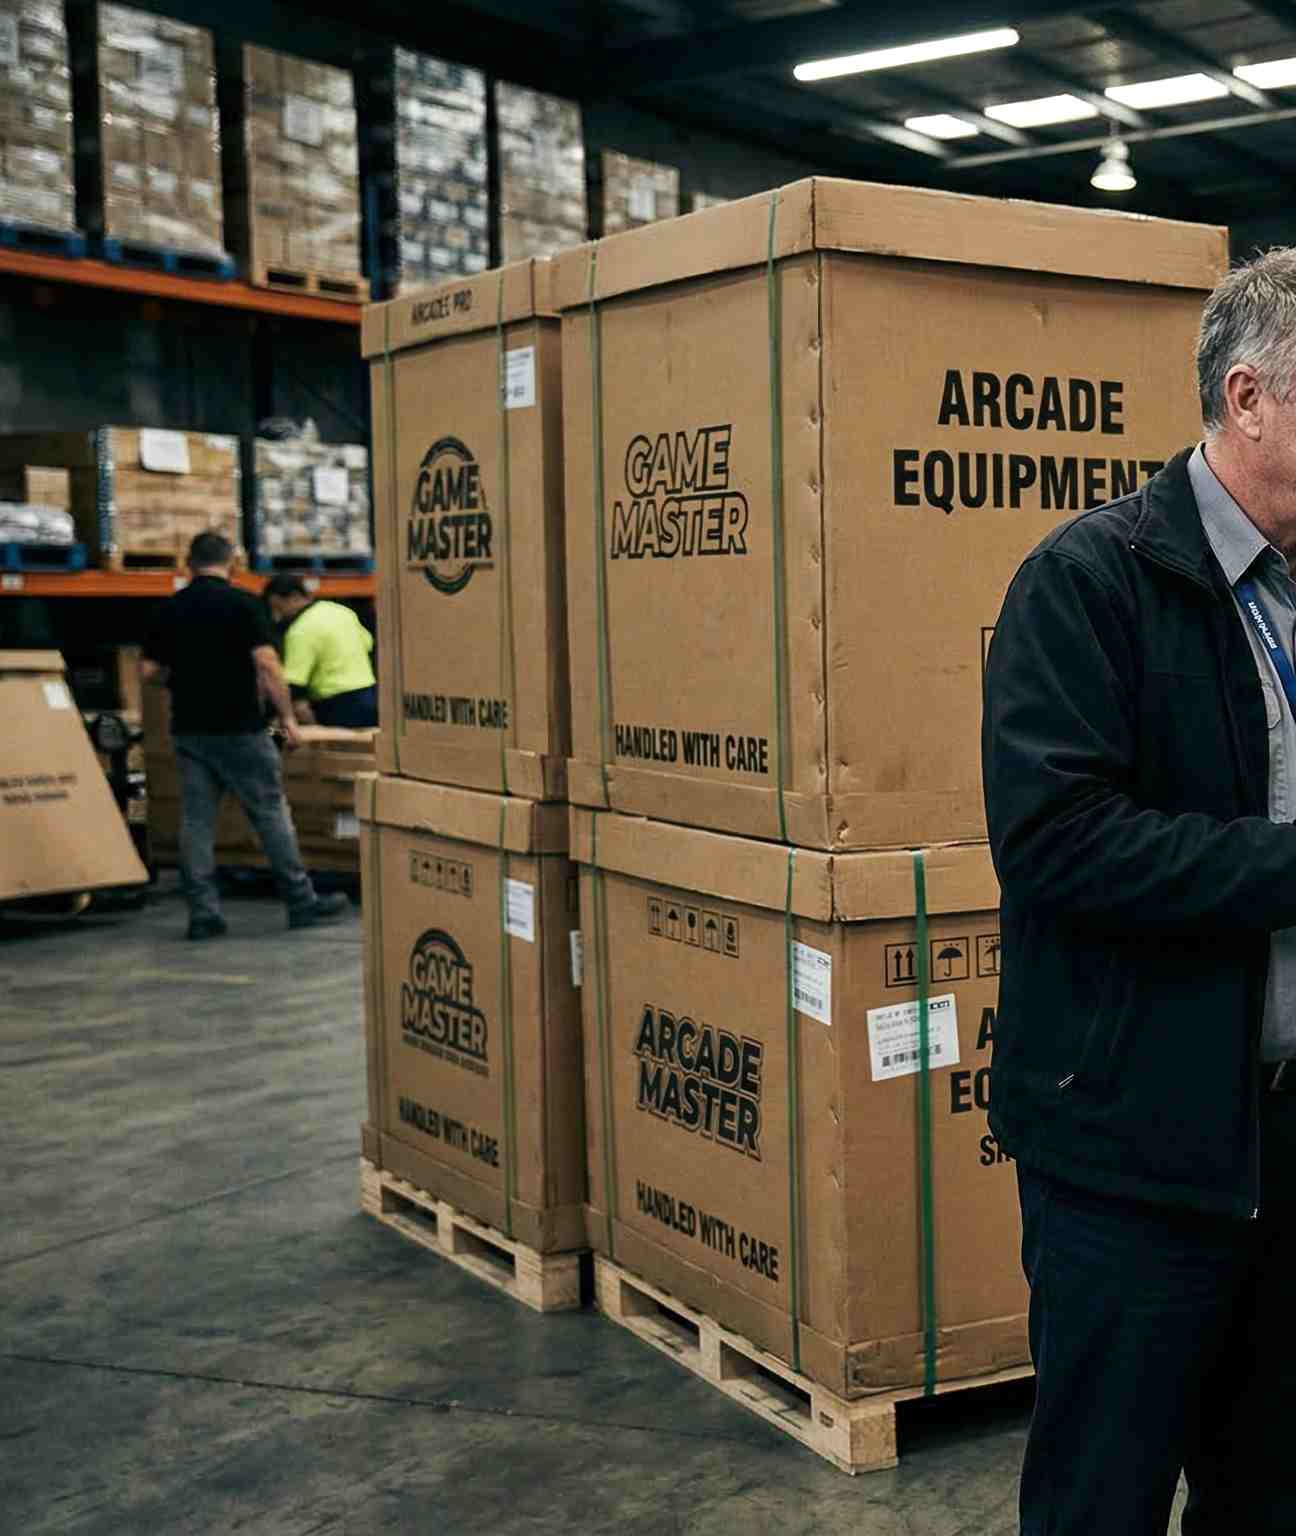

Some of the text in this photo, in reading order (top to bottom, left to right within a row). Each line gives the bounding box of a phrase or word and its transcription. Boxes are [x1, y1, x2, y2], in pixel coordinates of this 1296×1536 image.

[937, 369, 1124, 435] ARCADE
[416, 464, 480, 514] GAME
[625, 424, 732, 499] GAME
[408, 513, 493, 560] MASTER
[611, 491, 749, 560] MASTER
[403, 692, 509, 729] HANDLED WITH CARE
[615, 724, 769, 774] HANDLED WITH CARE
[410, 950, 474, 1008] GAME
[400, 981, 489, 1062] MASTER
[634, 1003, 764, 1102] ARCADE
[400, 1096, 499, 1168] HANDLED WITH CARE
[636, 1055, 763, 1162] MASTER
[636, 1179, 780, 1283] HANDLED WITH CARE
